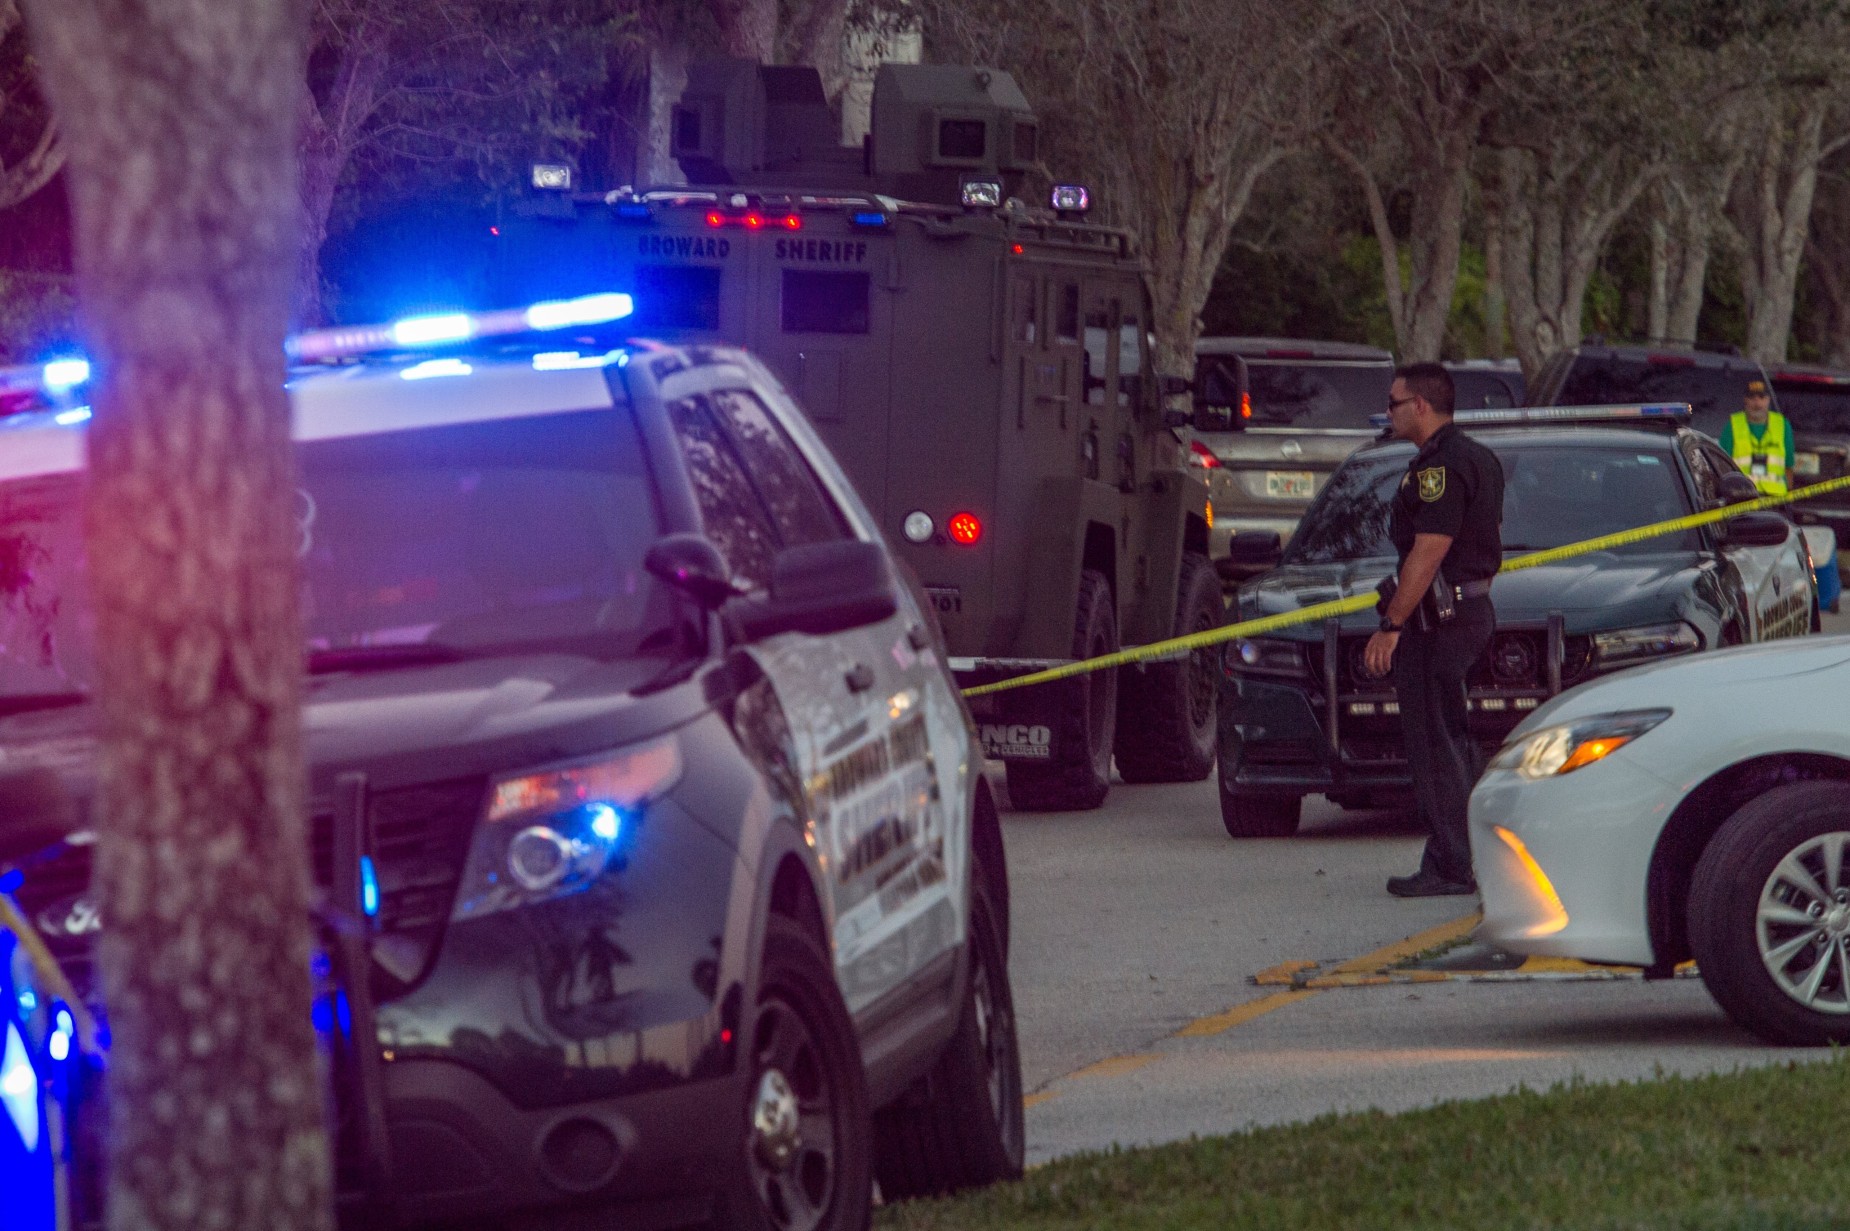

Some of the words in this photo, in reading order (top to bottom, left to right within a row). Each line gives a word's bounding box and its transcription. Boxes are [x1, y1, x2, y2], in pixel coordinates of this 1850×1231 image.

[638, 235, 730, 258] BROWARD
[775, 238, 867, 262] SHERIFF
[982, 724, 1050, 745] NCO
